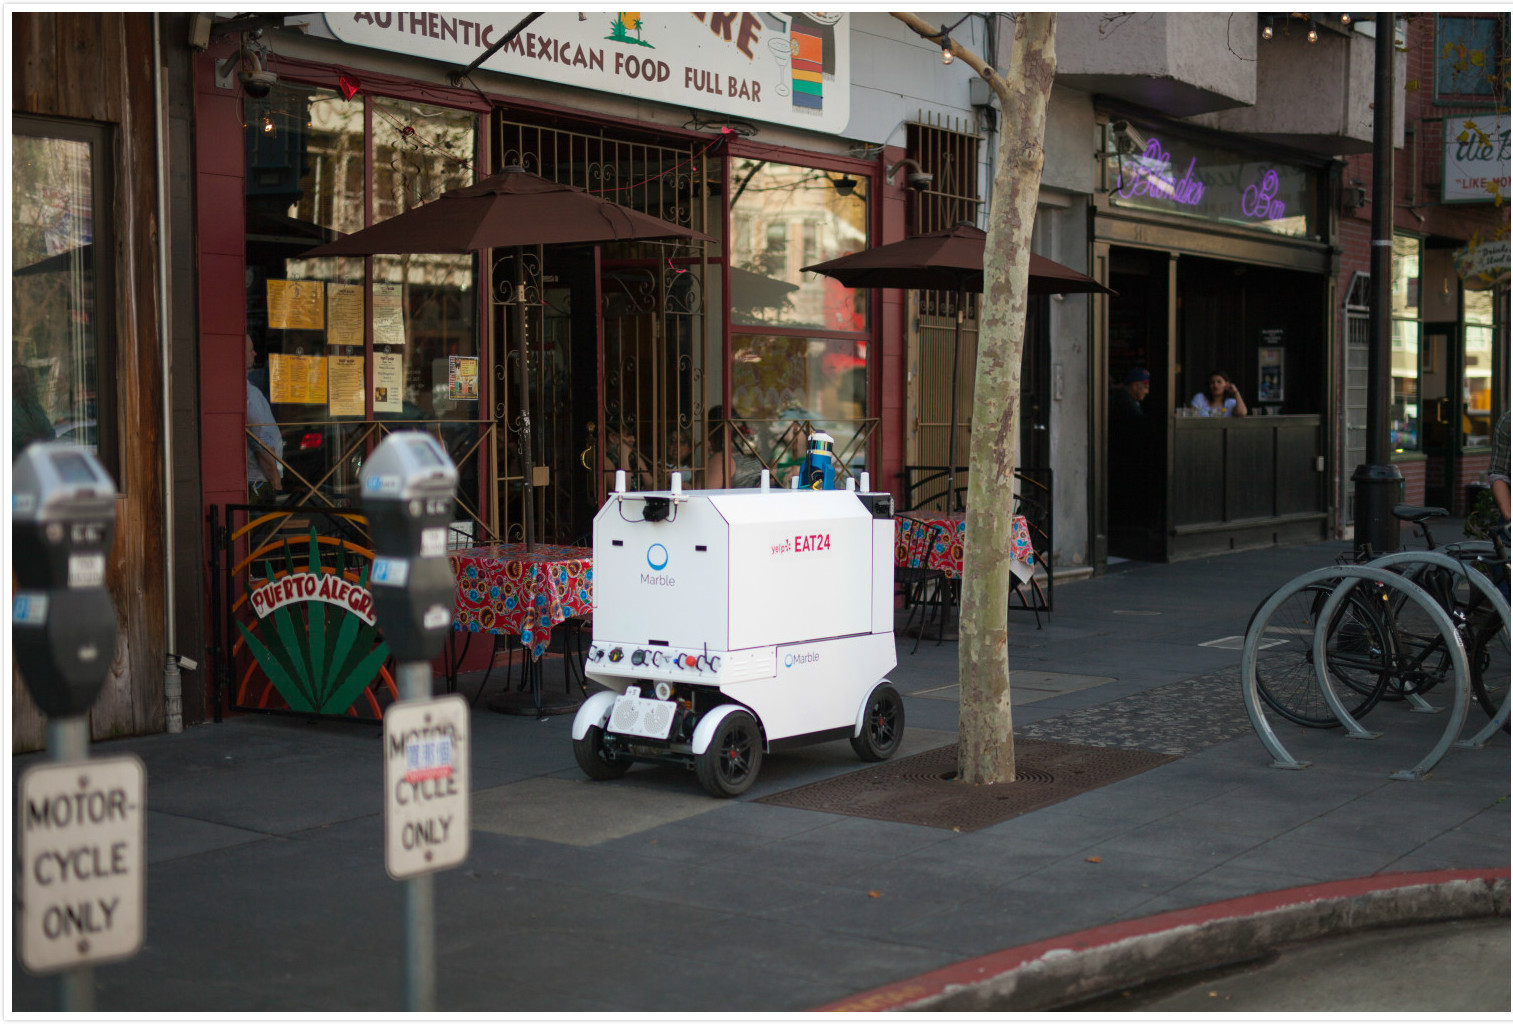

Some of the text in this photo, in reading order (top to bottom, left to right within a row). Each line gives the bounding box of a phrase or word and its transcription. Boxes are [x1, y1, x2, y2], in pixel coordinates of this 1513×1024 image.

[353, 12, 762, 103] AUTHENTIC MEXICAN FOOD FULL BAR
[794, 533, 831, 552] EAT24
[252, 575, 316, 610] PUERTO
[641, 573, 675, 587] Marble
[793, 651, 819, 665] Marble
[26, 787, 136, 834] MOTOR-
[402, 815, 453, 851] ONLY
[34, 842, 128, 887] CYCLE
[42, 897, 121, 941] ONLY
